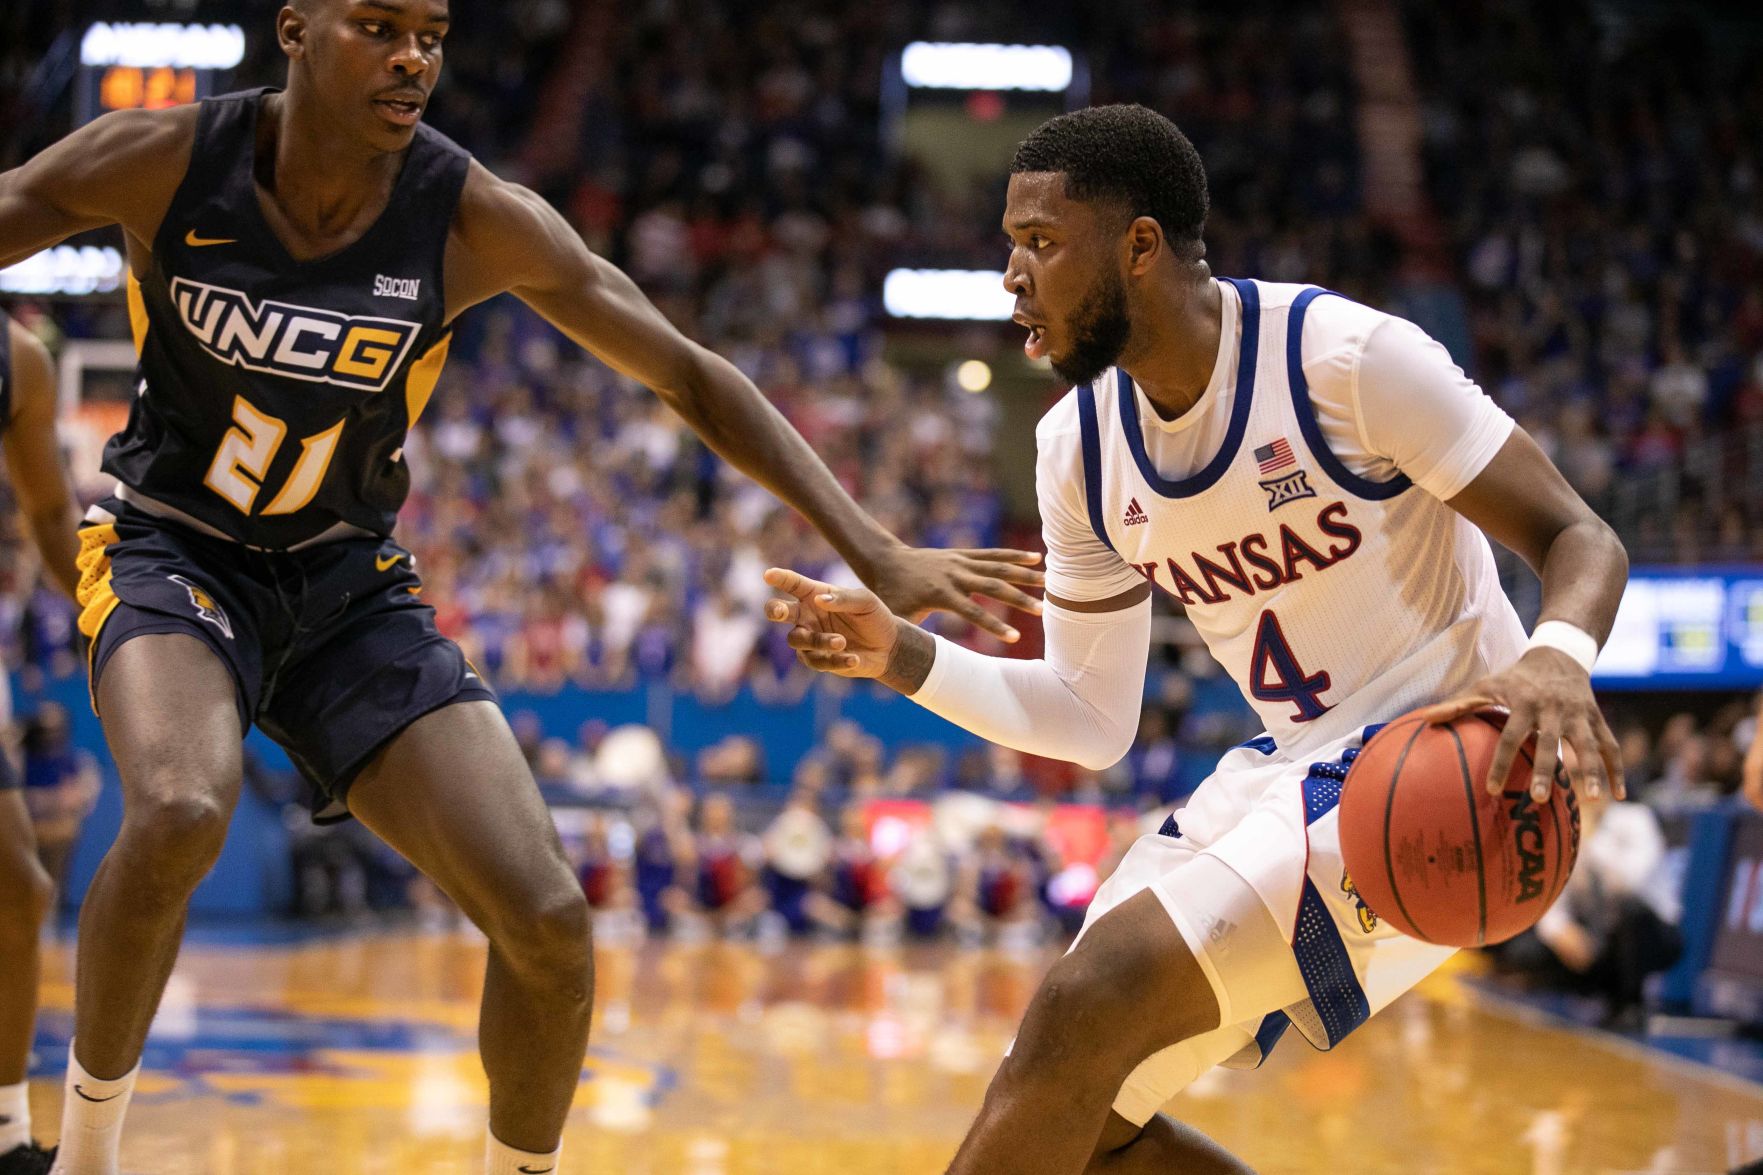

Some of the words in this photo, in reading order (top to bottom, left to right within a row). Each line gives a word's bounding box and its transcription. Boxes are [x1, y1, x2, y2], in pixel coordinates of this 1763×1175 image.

[174, 282, 412, 386] UNCG
[373, 274, 420, 300] SOCON
[203, 394, 346, 516] 21
[1123, 513, 1149, 526] adidas
[1249, 609, 1335, 723] 4
[1503, 789, 1545, 904] NCAA
